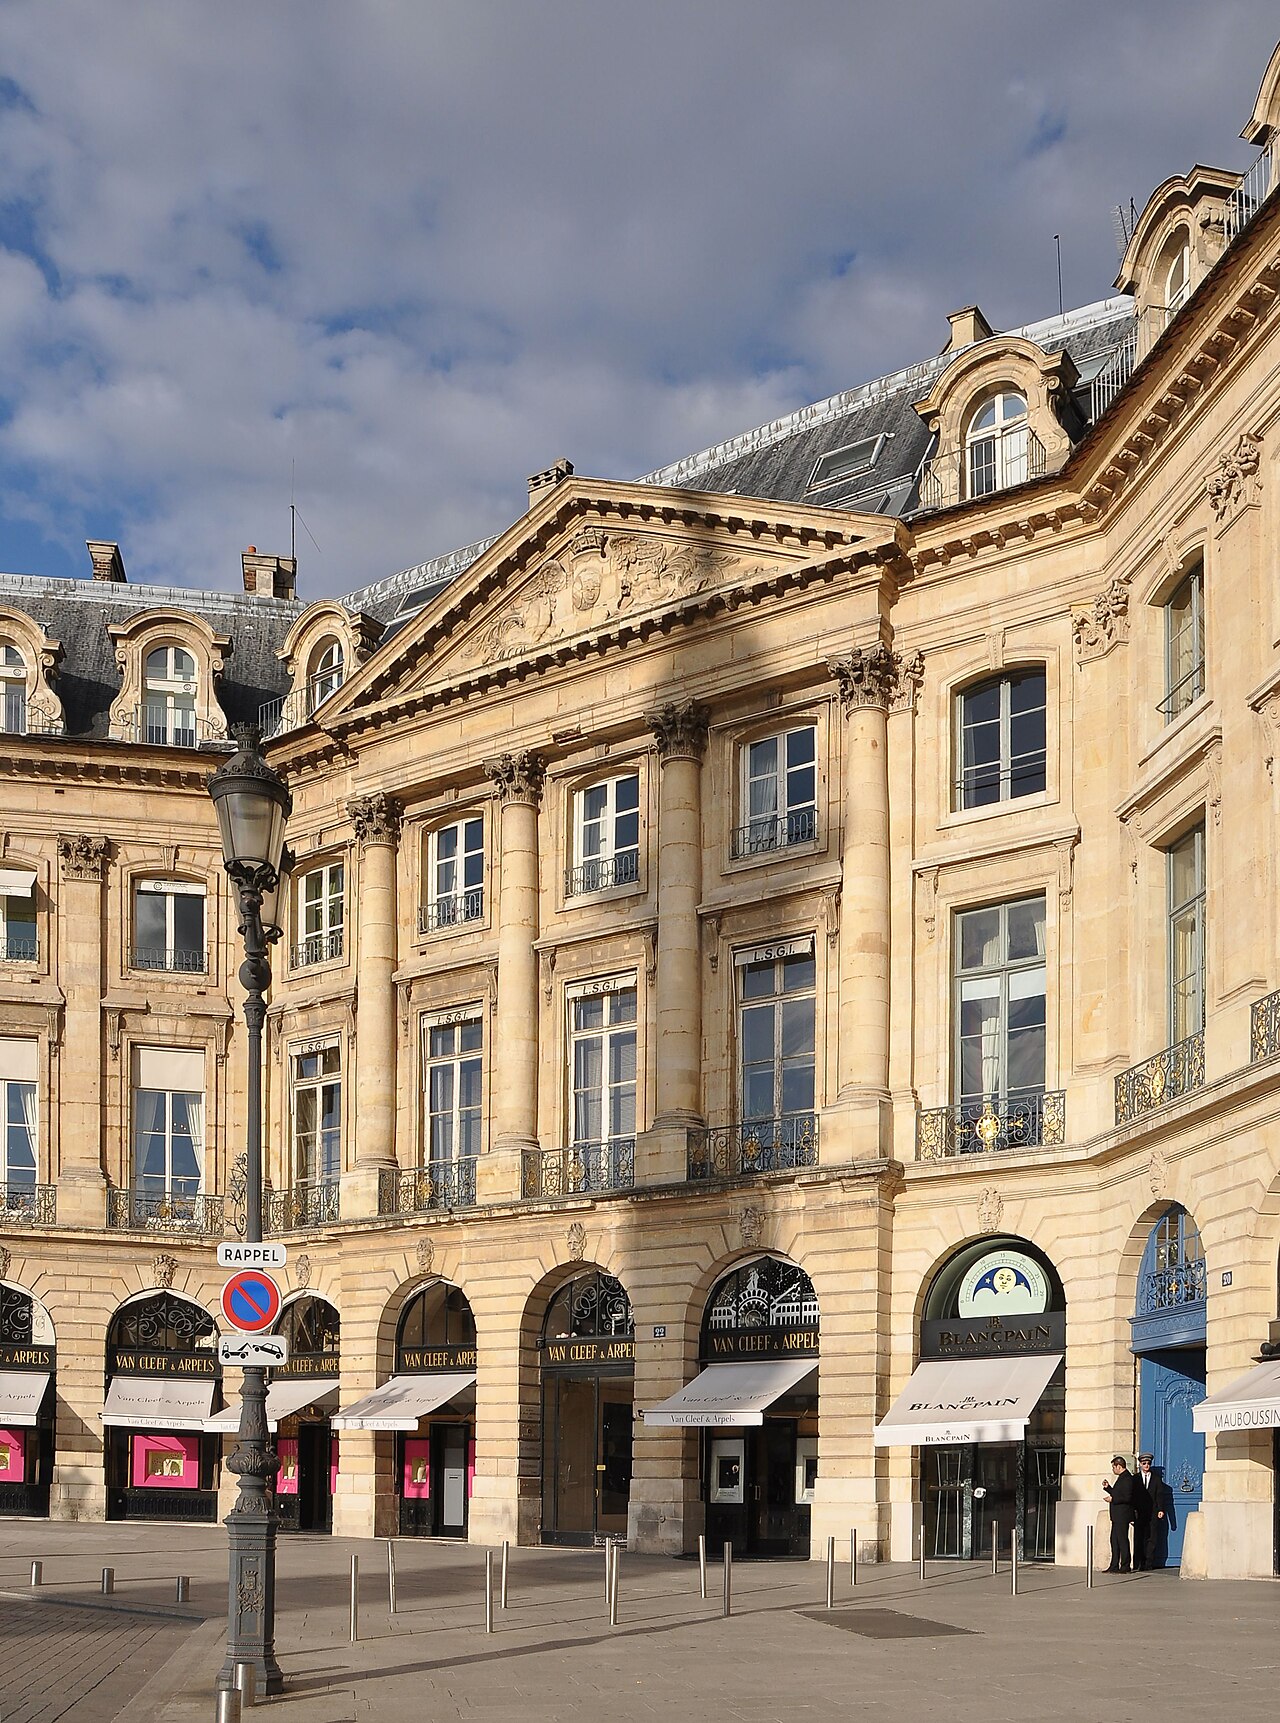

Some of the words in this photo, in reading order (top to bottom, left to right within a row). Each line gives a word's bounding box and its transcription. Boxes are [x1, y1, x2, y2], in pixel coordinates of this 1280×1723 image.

[753, 944, 795, 962] L.S.G.I.
[582, 981, 619, 995] L.S.G.I.
[224, 1248, 279, 1262] RAPPEL
[654, 1327, 665, 1337] 22
[938, 1325, 1052, 1346] BLANCPAIN
[713, 1336, 734, 1353] VAN
[738, 1334, 771, 1352] CLEEF
[773, 1341, 779, 1350] &
[12, 1350, 50, 1365] ARPELS
[404, 1352, 421, 1367] VAN
[423, 1351, 449, 1367] CLEEF
[449, 1358, 454, 1366] &
[455, 1350, 476, 1366] ARPE
[548, 1346, 566, 1361] VAN
[570, 1344, 598, 1360] CLEEF
[599, 1350, 605, 1359] &
[115, 1355, 135, 1369] VAN
[140, 1356, 168, 1371] CLEEF
[170, 1363, 176, 1371] &
[177, 1358, 215, 1372] ARPELS
[292, 1359, 313, 1373] CLEEF
[320, 1358, 338, 1371] ARPE
[907, 1397, 1021, 1411] BLANCPAIN
[670, 1414, 684, 1423] Van
[685, 1414, 704, 1423] Cleef
[713, 1414, 736, 1425] Arpels
[1214, 1409, 1280, 1428] MAUBOUSSIN
[925, 1433, 971, 1442] BLANCPAIN
